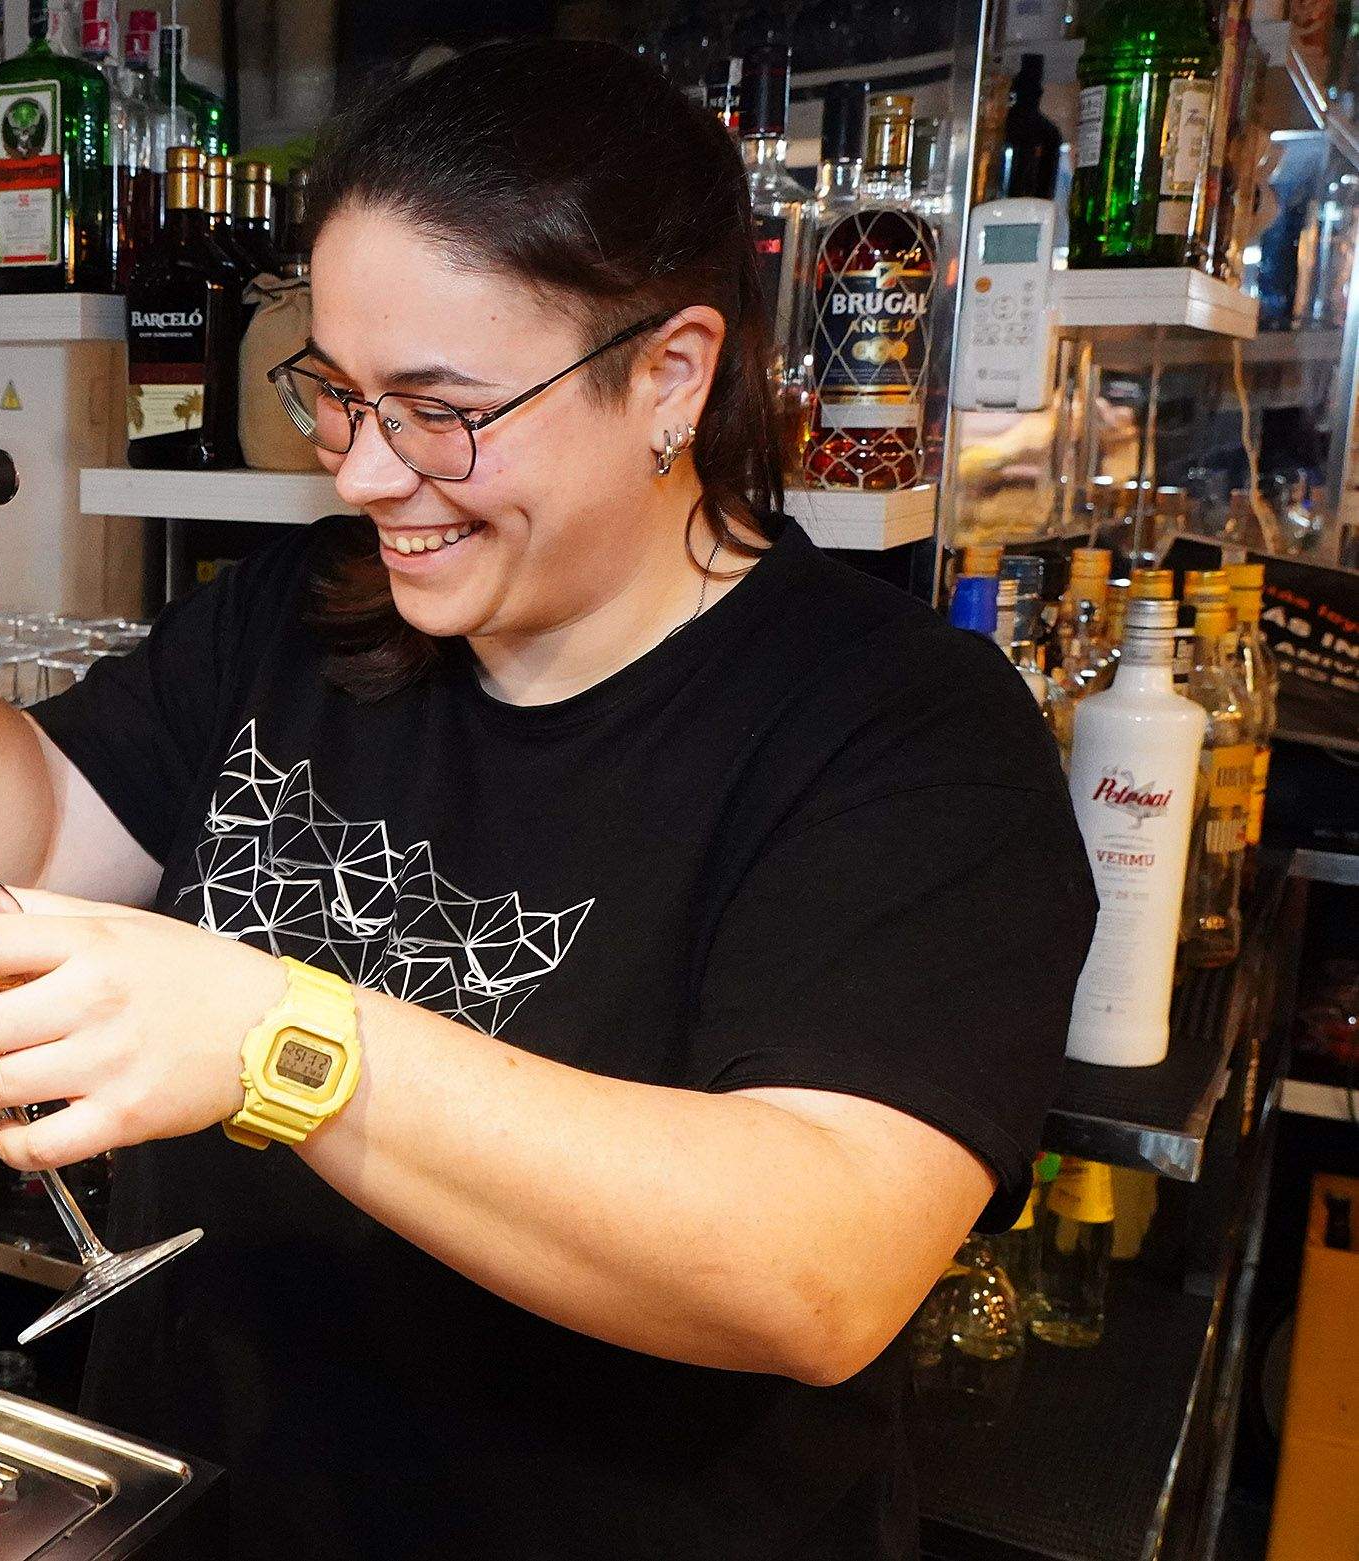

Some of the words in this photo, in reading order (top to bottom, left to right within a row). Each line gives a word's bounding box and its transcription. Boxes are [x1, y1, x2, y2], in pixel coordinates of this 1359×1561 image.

[831, 291, 928, 316] BRUGAL
[131, 308, 204, 329] BARCELÓ
[1096, 850, 1156, 867] VERMU
